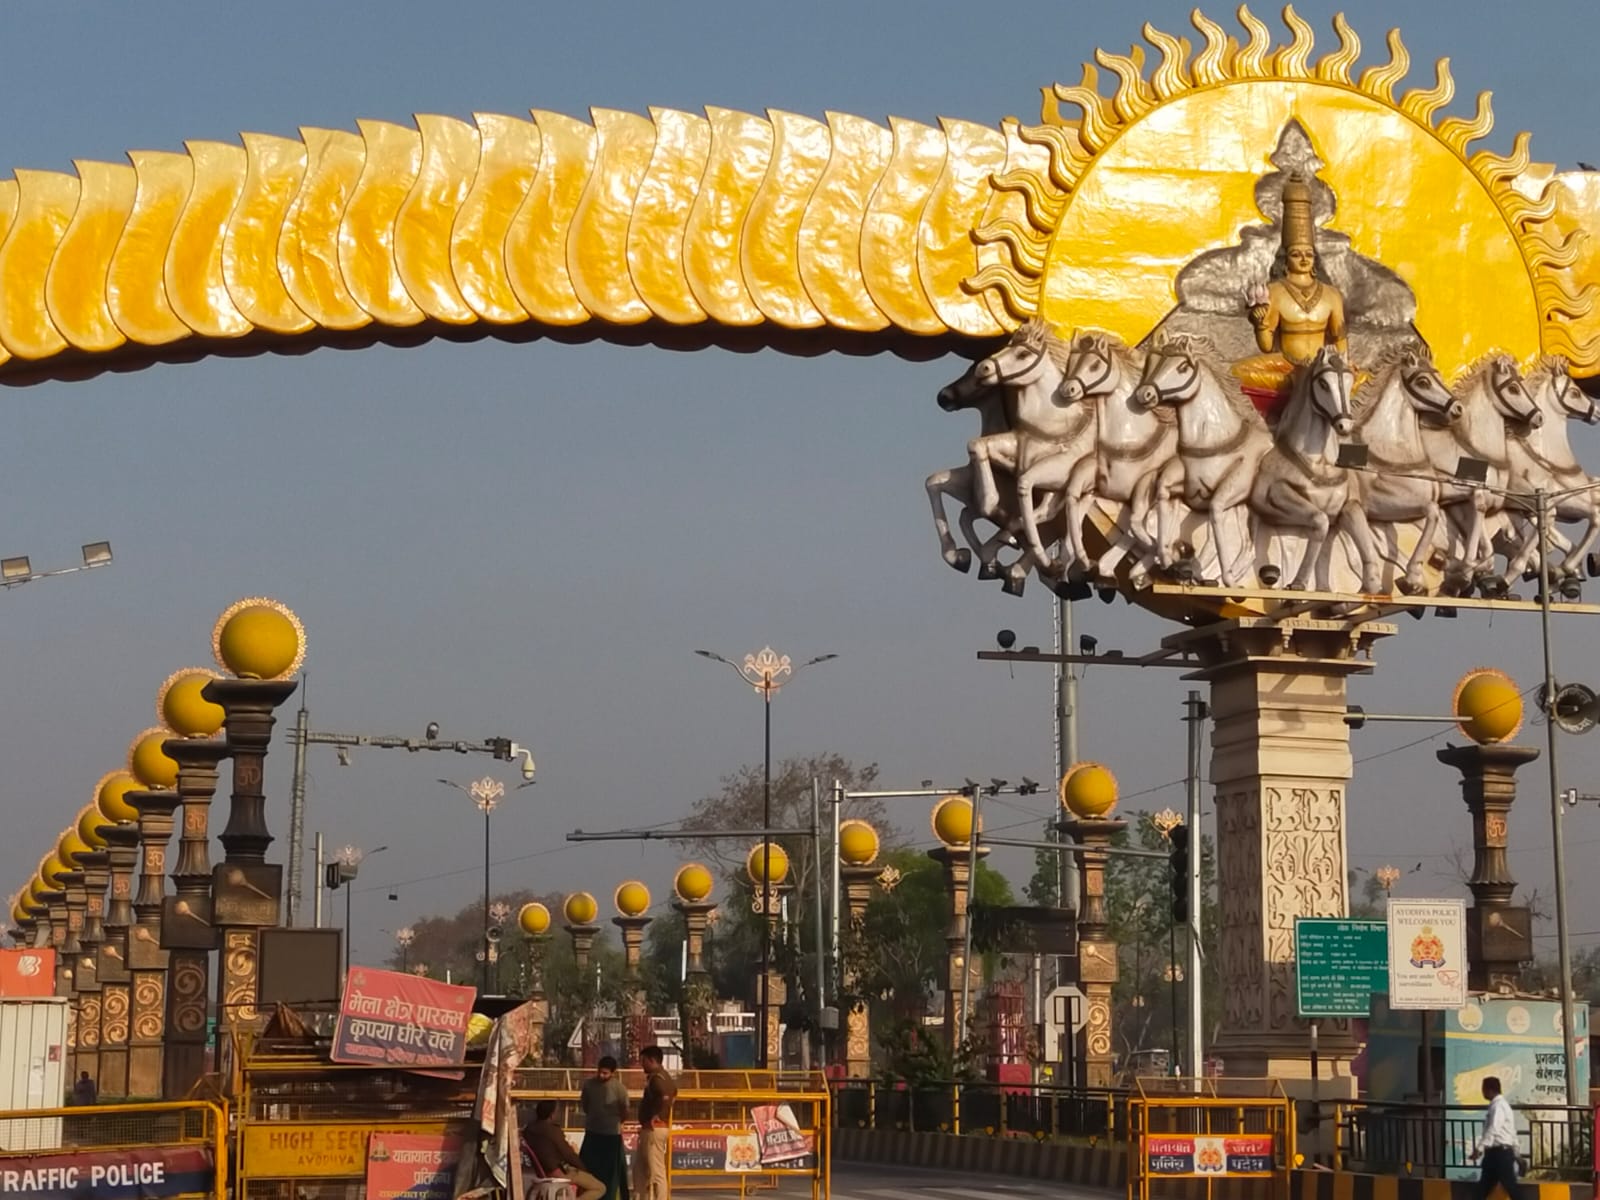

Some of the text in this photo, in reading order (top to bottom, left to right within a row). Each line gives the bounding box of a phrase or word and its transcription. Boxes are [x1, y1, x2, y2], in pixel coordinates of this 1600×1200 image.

[349, 990, 465, 1028] मेला क्षेत्र प्रारम्भ
[350, 1018, 395, 1042] कृपया
[269, 1131, 313, 1150] HIGH
[392, 1150, 432, 1164] यातायात
[0, 1162, 165, 1192] RAFFIC POLICE
